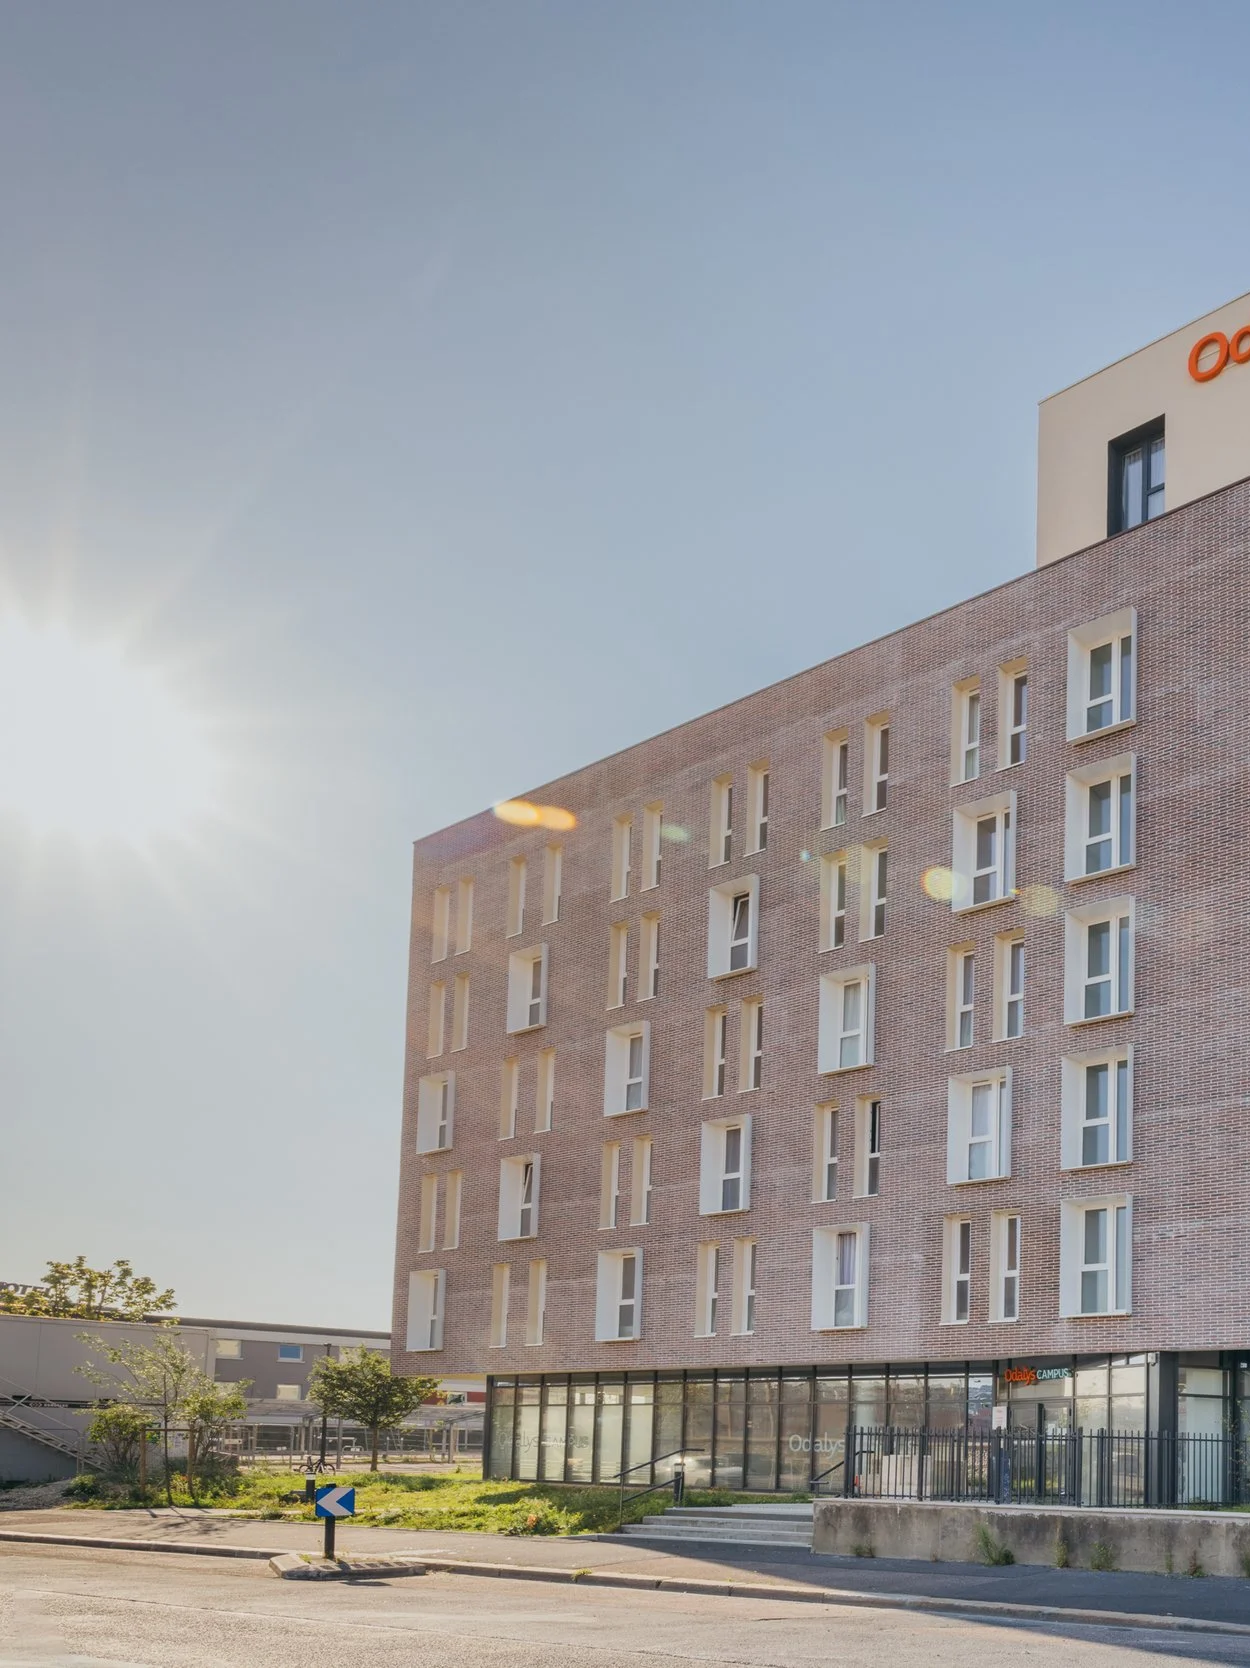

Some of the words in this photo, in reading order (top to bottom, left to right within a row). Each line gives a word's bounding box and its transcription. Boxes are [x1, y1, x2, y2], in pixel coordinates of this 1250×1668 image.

[1004, 1366, 1036, 1386] Odalys
[1037, 1368, 1069, 1380] CAMPUS
[789, 1431, 846, 1459] Odalys
